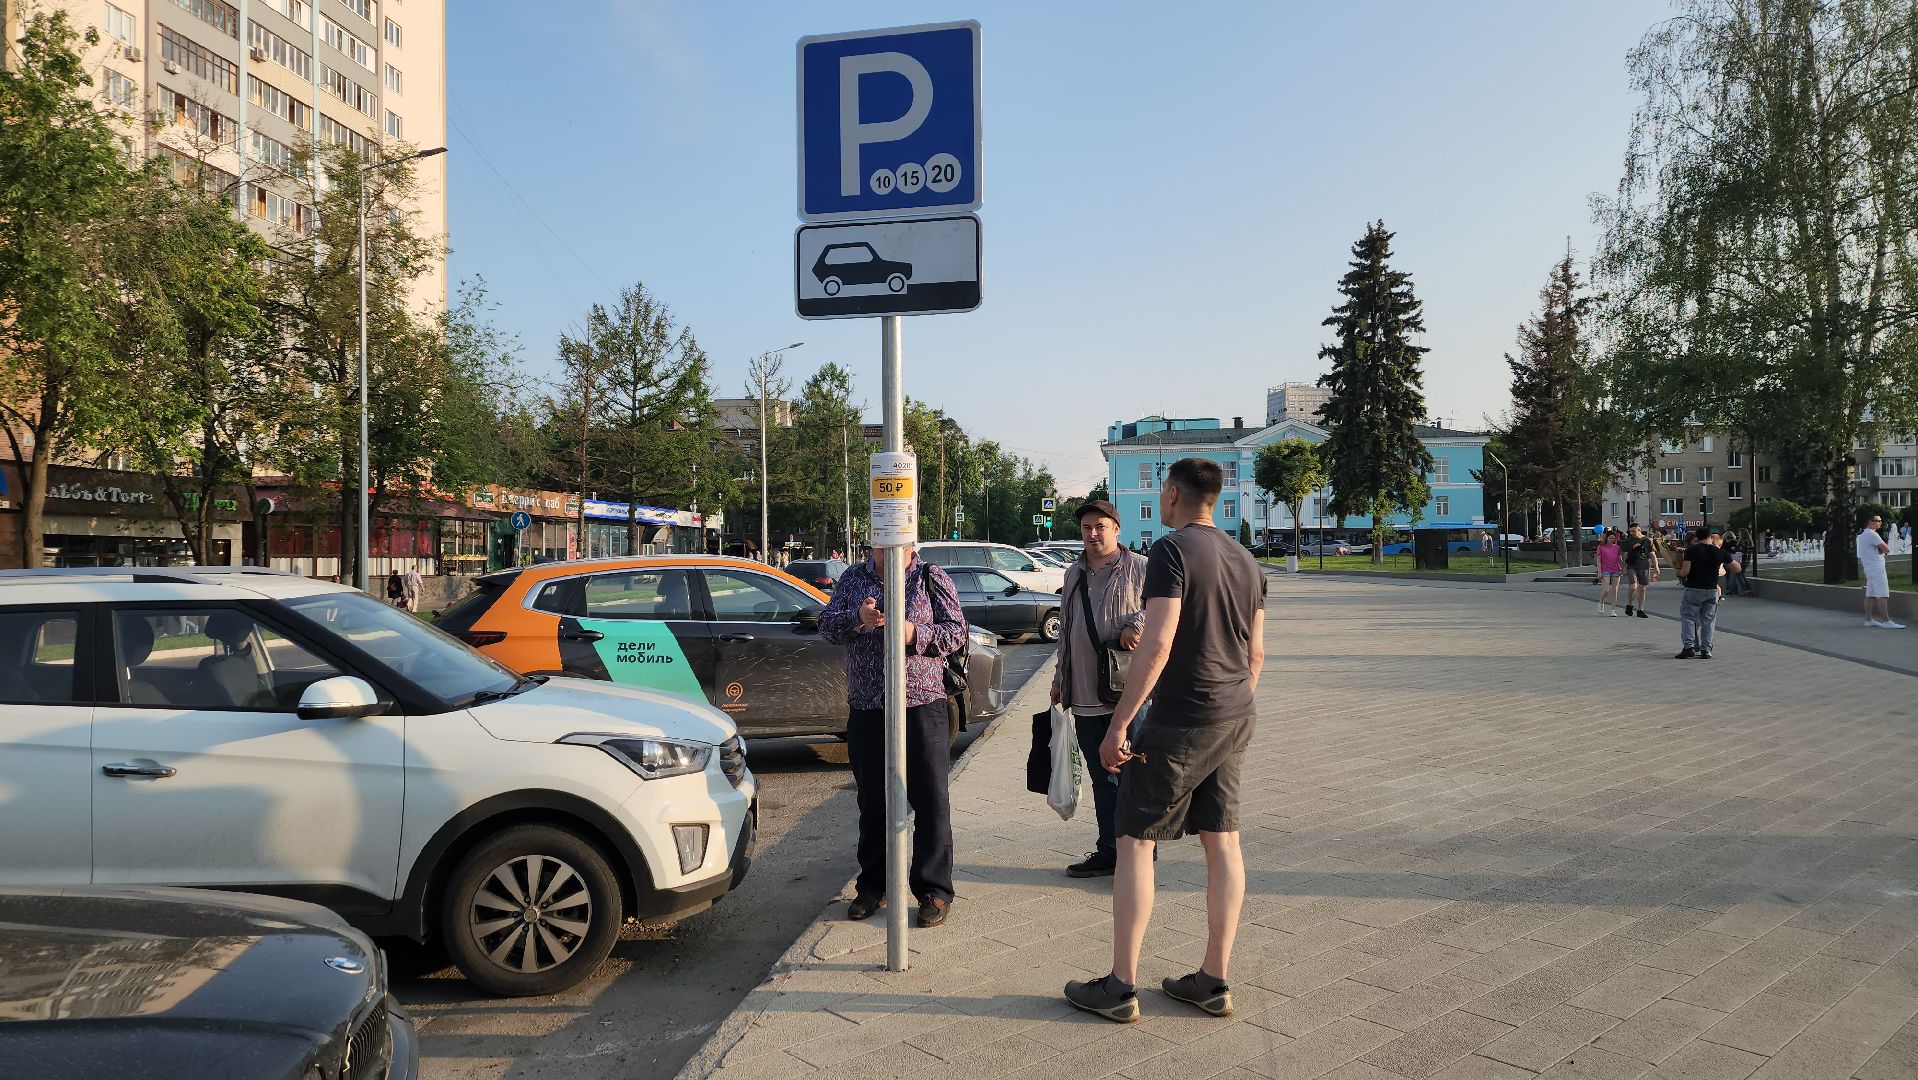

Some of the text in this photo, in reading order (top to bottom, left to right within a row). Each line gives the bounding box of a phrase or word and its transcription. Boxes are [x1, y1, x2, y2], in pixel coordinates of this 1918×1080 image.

[839, 51, 934, 197] P
[875, 163, 955, 189] 10 15 20
[879, 482, 893, 493] 50
[617, 642, 656, 652] дели
[616, 651, 674, 663] мобиль
